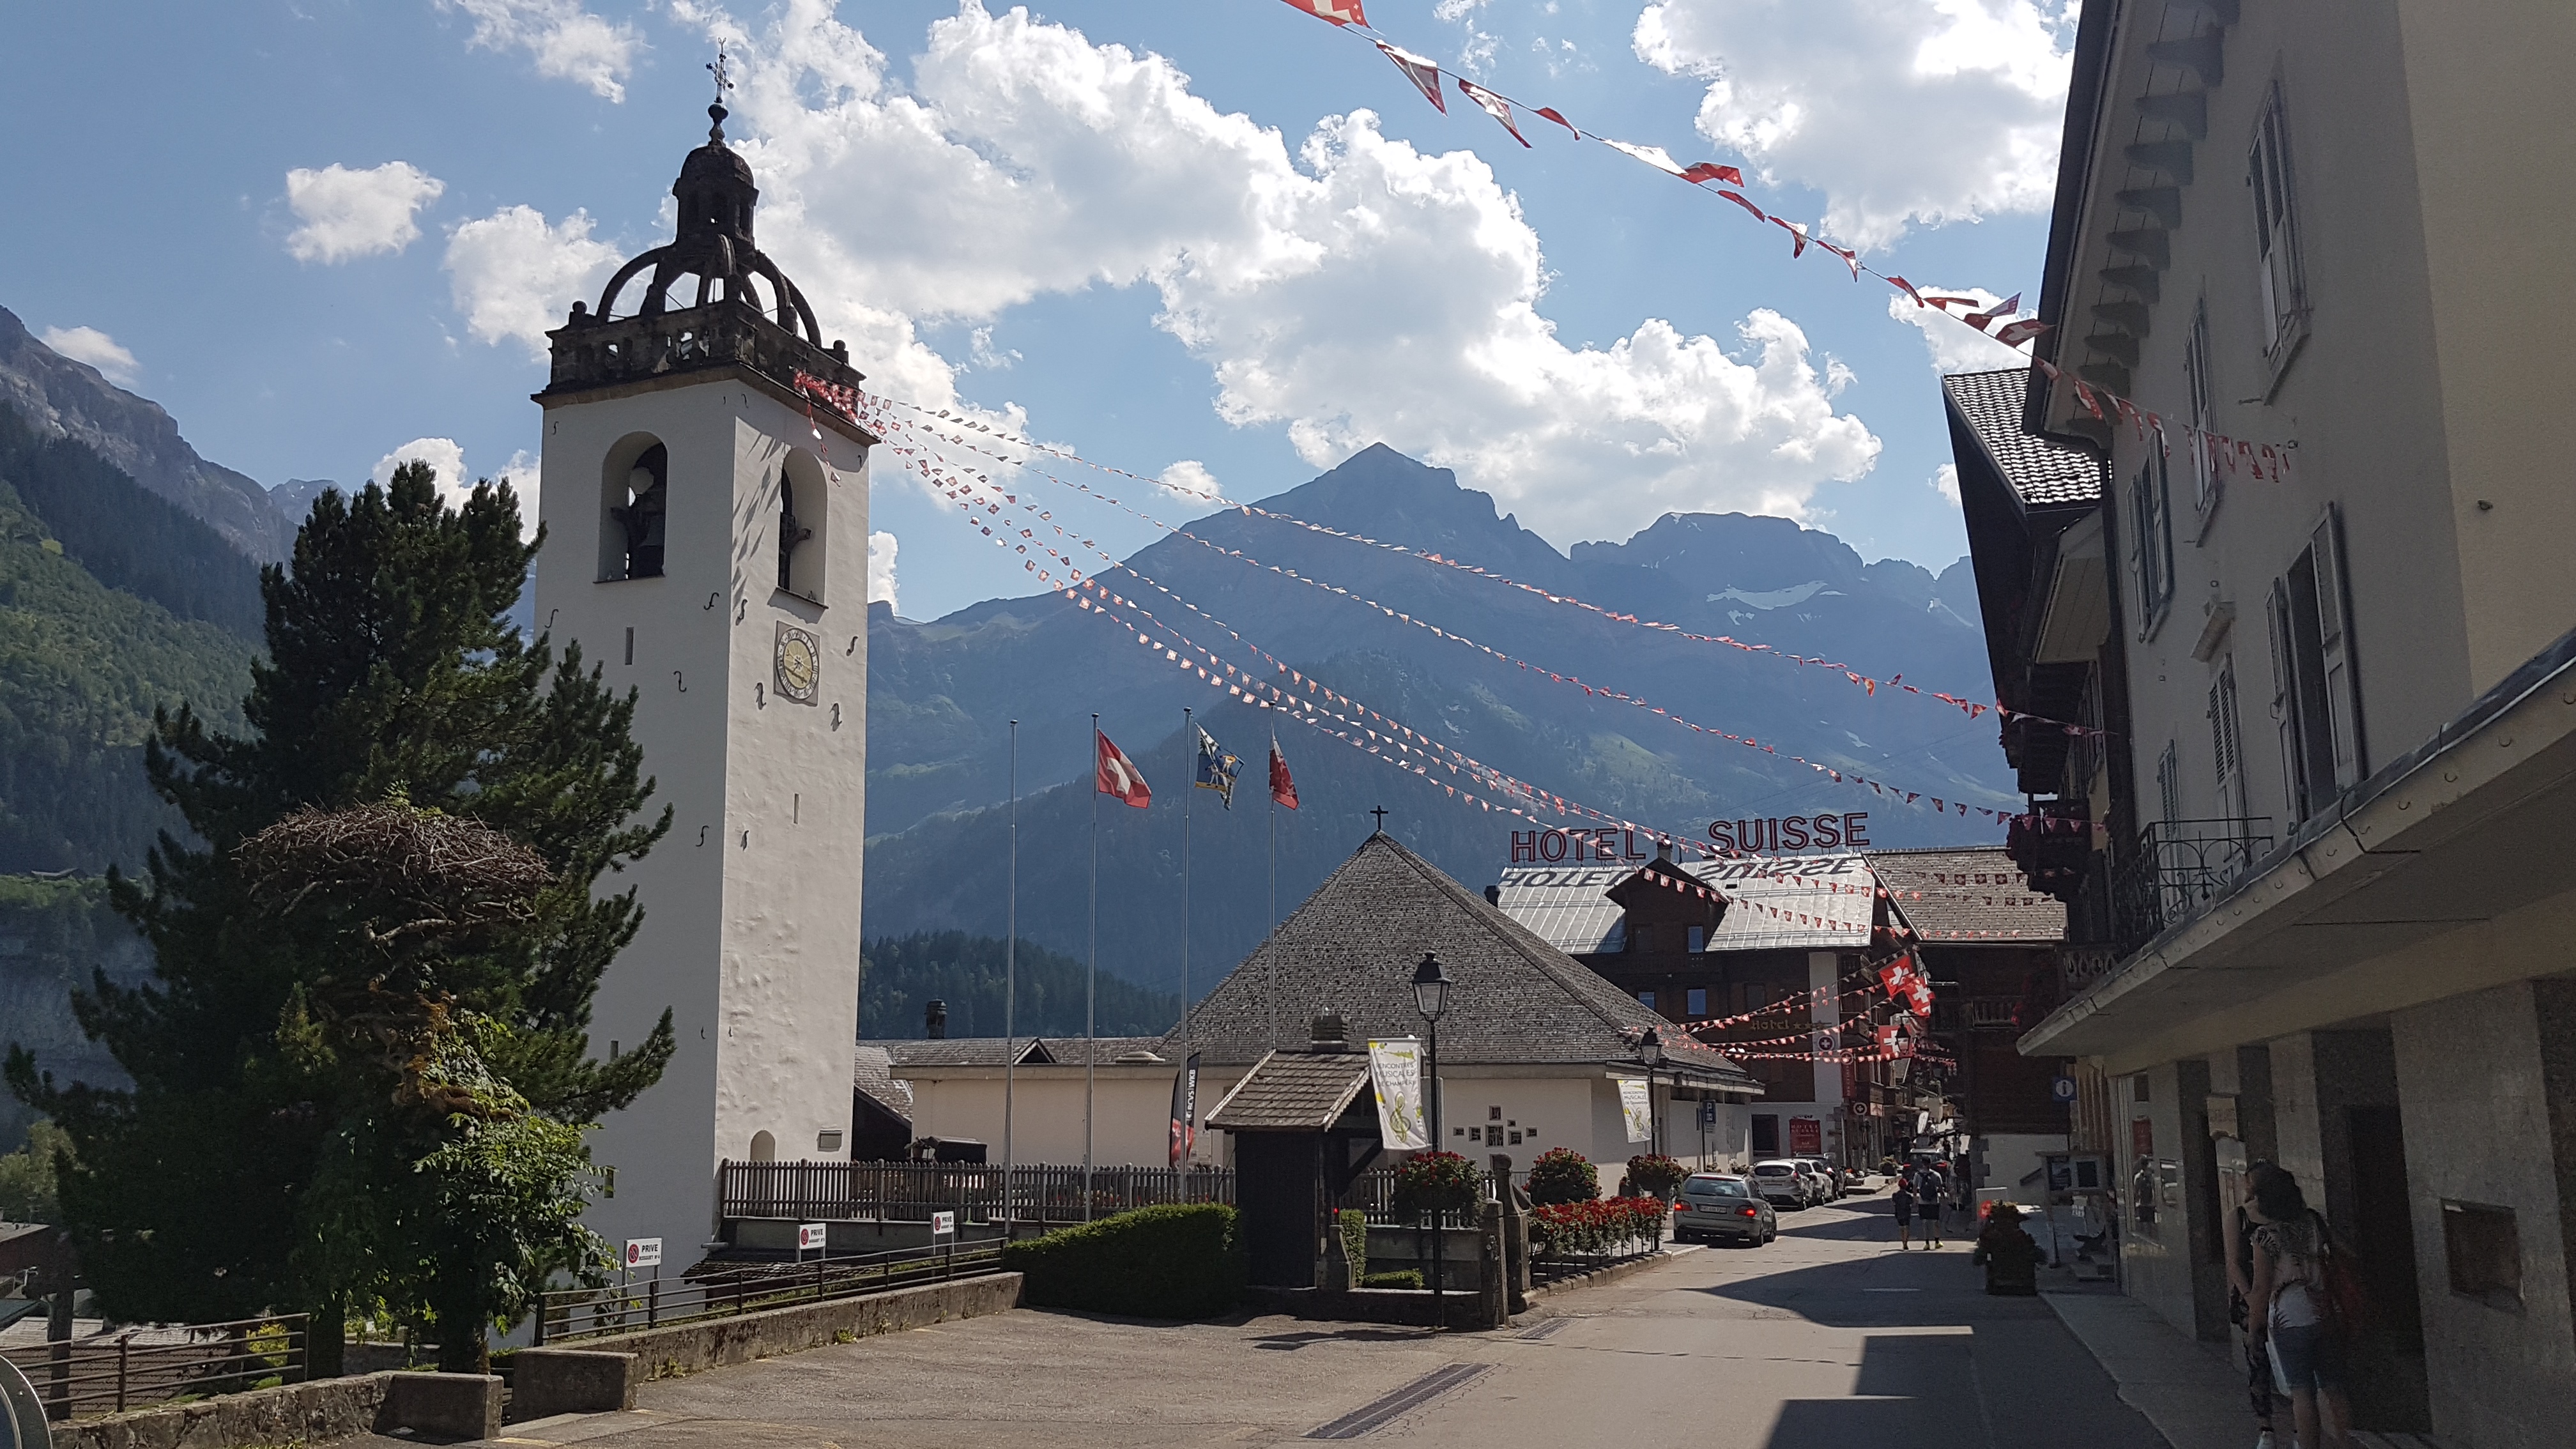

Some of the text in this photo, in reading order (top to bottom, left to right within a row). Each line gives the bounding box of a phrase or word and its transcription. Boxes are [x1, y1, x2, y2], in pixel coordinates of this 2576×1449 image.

[1511, 812, 1870, 862] HOTEL SUISSE
[1706, 1102, 1712, 1112] P
[641, 1244, 658, 1253] PRIVE
